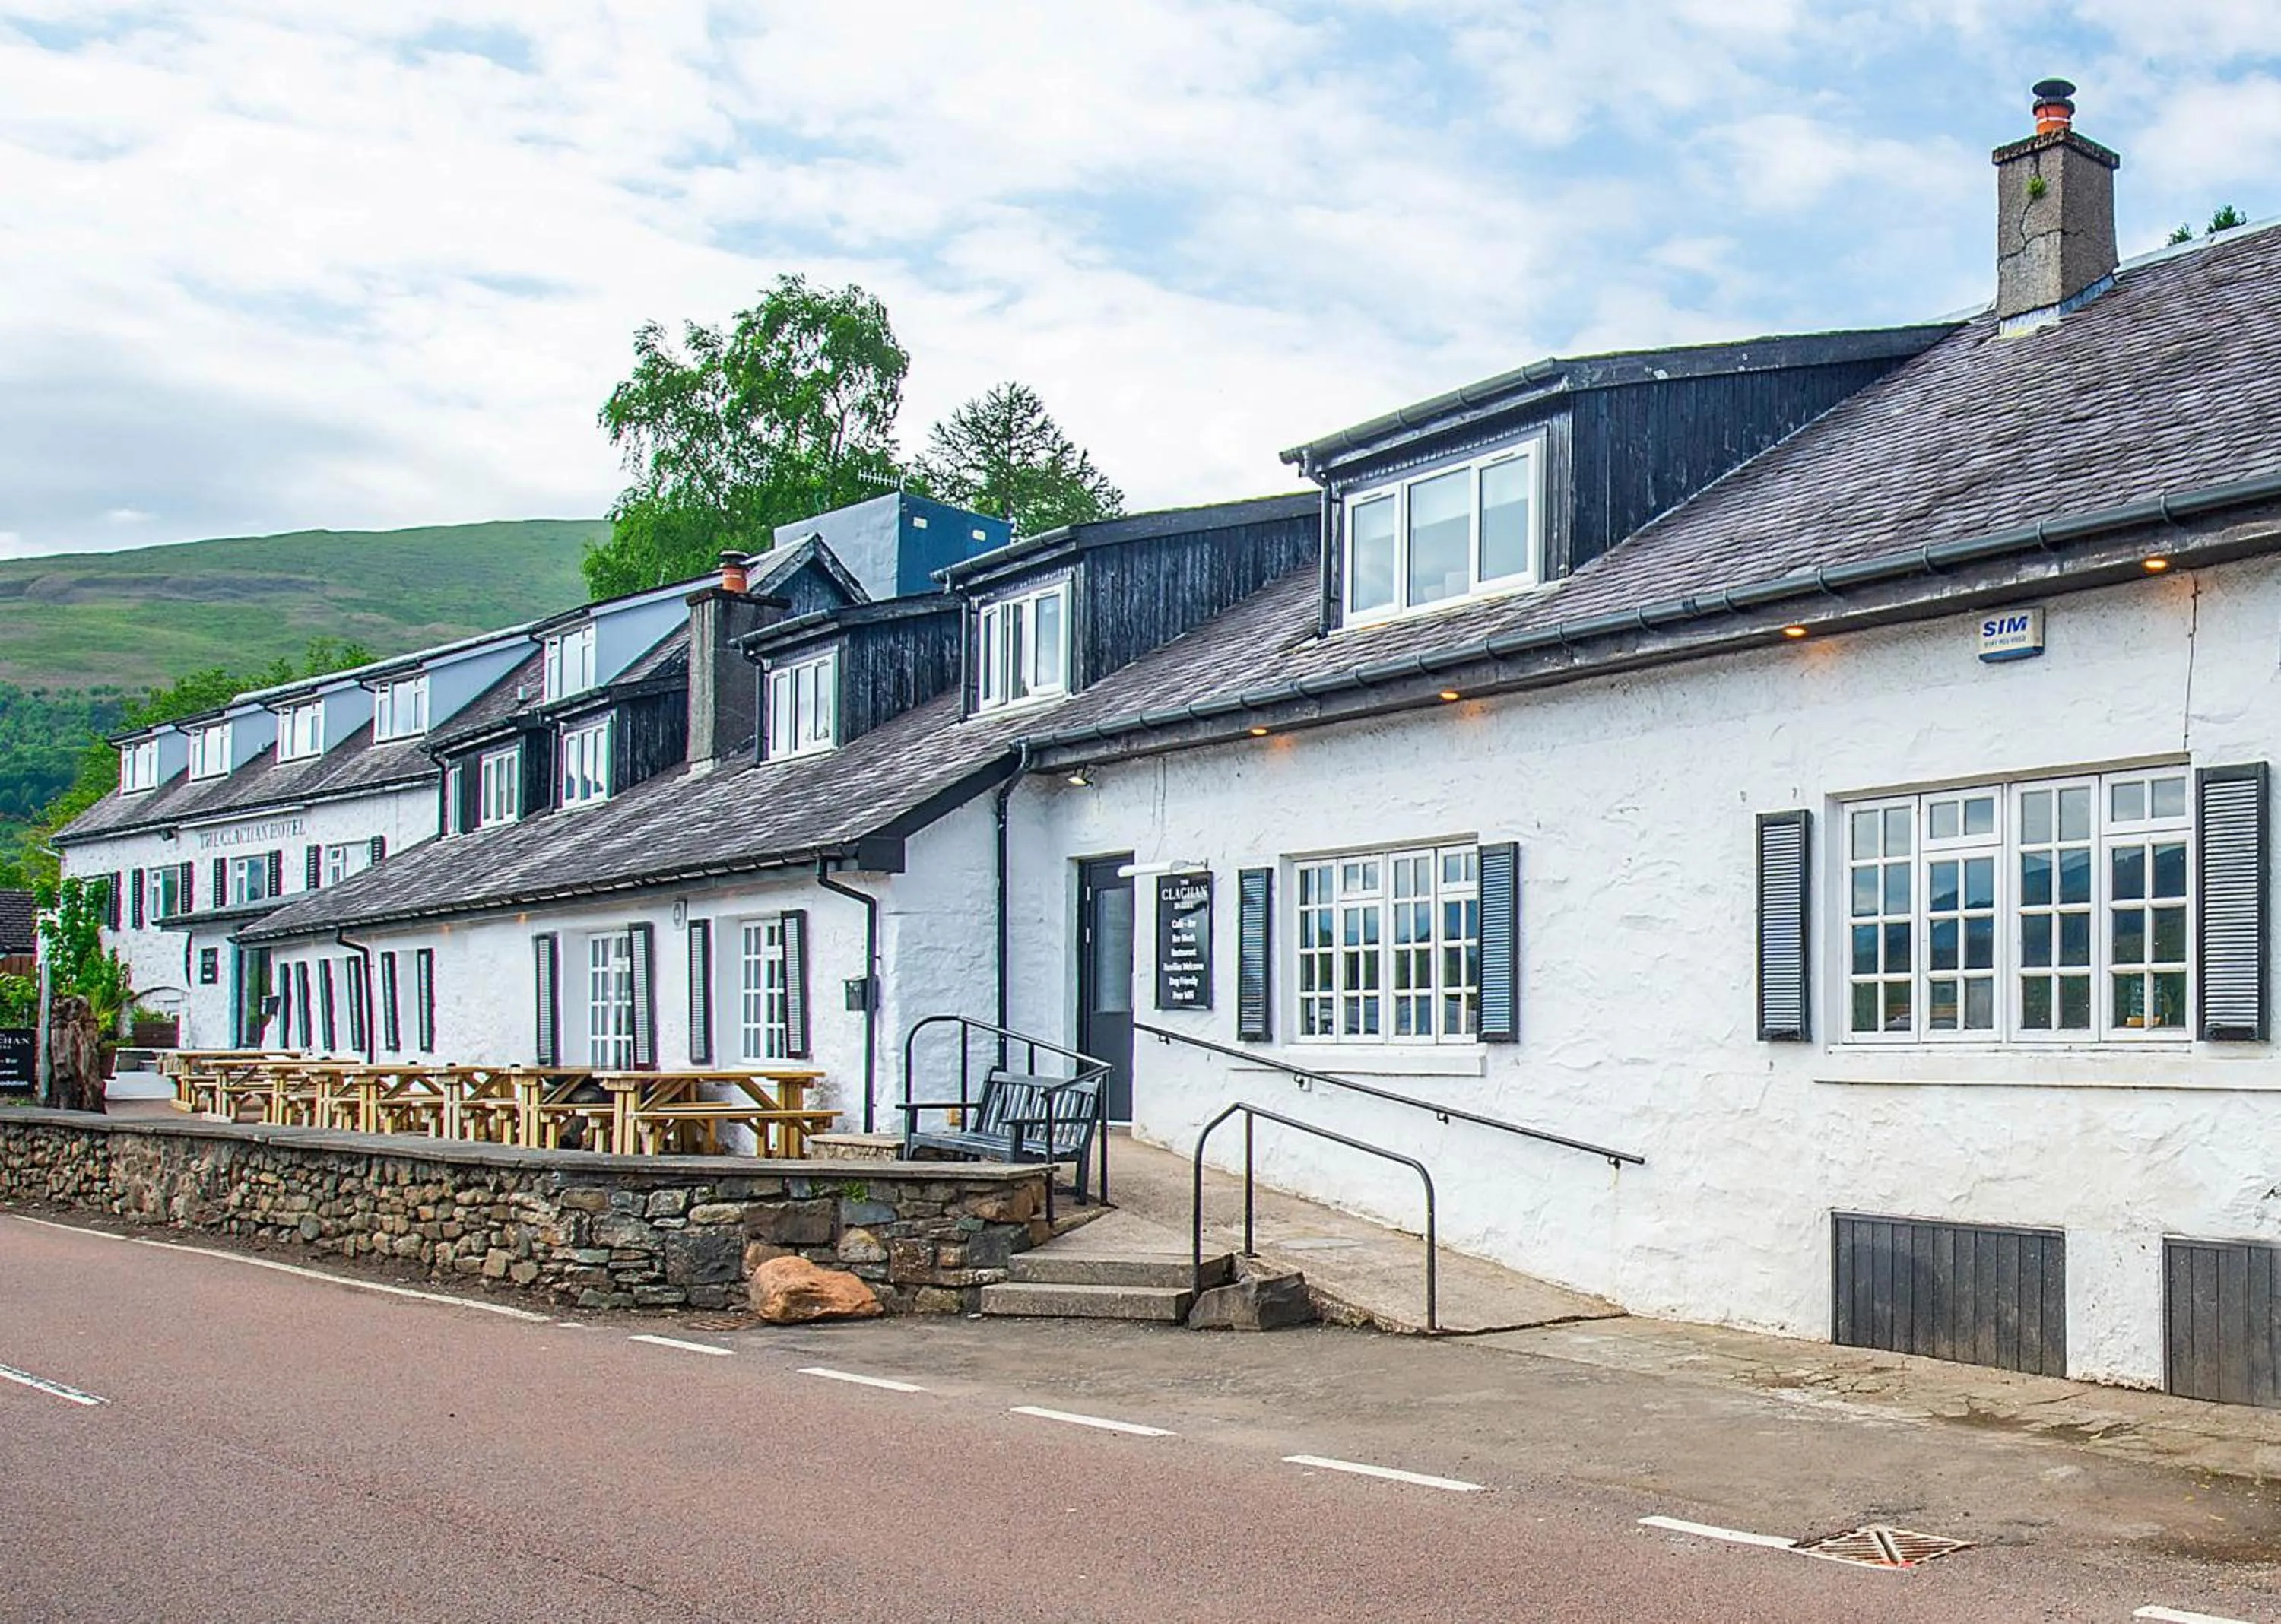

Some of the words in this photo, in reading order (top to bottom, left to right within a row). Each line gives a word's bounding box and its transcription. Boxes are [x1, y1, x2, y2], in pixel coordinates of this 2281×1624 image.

[1983, 615, 2028, 637] SIM
[200, 832, 220, 849] THE
[270, 818, 306, 839] HOTEL
[1161, 884, 1207, 901] CLACHAN
